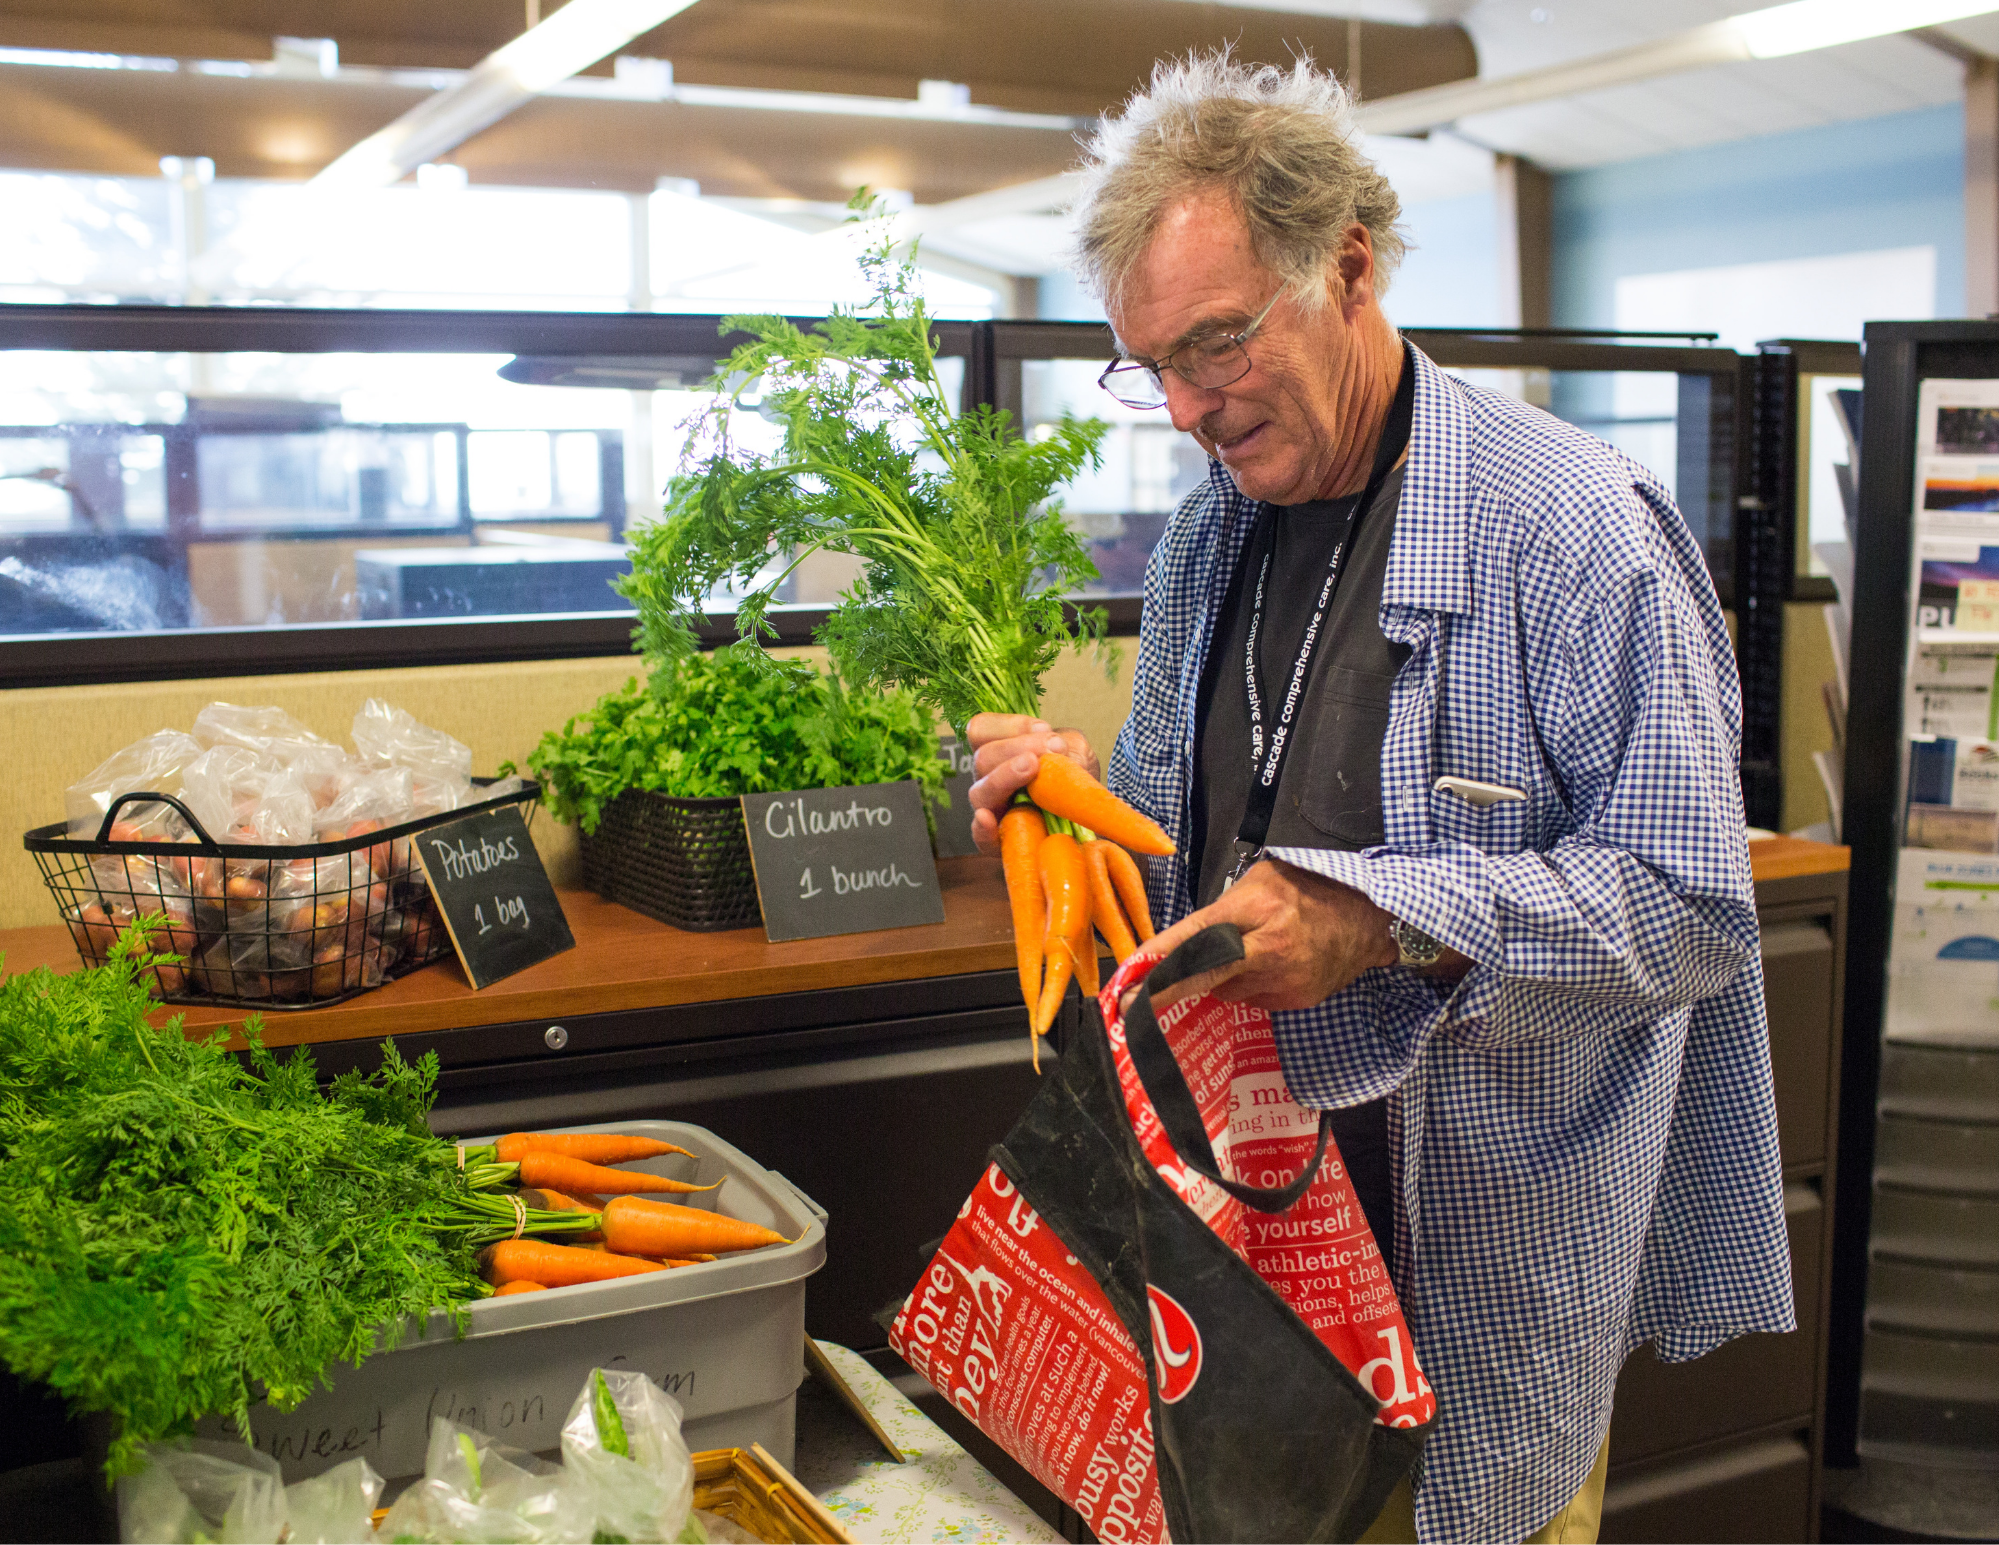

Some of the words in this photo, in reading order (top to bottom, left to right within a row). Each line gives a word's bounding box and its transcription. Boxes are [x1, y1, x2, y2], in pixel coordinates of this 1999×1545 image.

[1255, 554, 1269, 609] cascade
[1246, 613, 1261, 721] comprehensive
[1262, 726, 1288, 786] cascade
[1281, 611, 1322, 723] comprehensive
[1318, 573, 1336, 609] care,
[1329, 542, 1342, 568] inc.
[765, 798, 892, 839] Cilantro
[430, 836, 519, 881] Potatoes
[800, 868, 822, 898] 1
[832, 864, 922, 894] bunch
[474, 907, 492, 934] 1
[498, 895, 530, 929] bag
[1188, 1035, 1214, 1062] worse
[1212, 1021, 1227, 1039] for
[1202, 1052, 1218, 1076] get
[1215, 1040, 1231, 1056] the
[1237, 1058, 1249, 1068] an
[1195, 1080, 1210, 1104] of
[1270, 1111, 1290, 1128] in
[1232, 1149, 1247, 1160] the
[1249, 1145, 1277, 1156] words
[1260, 1167, 1294, 1188] on
[1307, 1190, 1345, 1210] how
[1256, 1206, 1351, 1244] yourself
[972, 1220, 990, 1244] that
[991, 1238, 1014, 1268] flows
[1015, 1266, 1038, 1288] over
[1039, 1285, 1058, 1304] the
[1060, 1300, 1089, 1329] water
[977, 1205, 995, 1230] live
[995, 1226, 1018, 1252] near
[1019, 1249, 1038, 1271] the
[1039, 1268, 1076, 1300] ocean
[1077, 1297, 1100, 1320] and
[1098, 1313, 1135, 1352] inhale
[1299, 1276, 1342, 1297] you
[1348, 1264, 1379, 1285] the
[1348, 1284, 1390, 1306] helps
[942, 1296, 972, 1356] than
[1005, 1321, 1020, 1351] health
[1017, 1295, 1031, 1324] goals
[1024, 1330, 1032, 1339] a
[1027, 1305, 1043, 1332] year.
[1313, 1312, 1346, 1329] and
[1012, 1338, 1028, 1369] times
[1024, 1314, 1055, 1372] computer.
[1005, 1367, 1016, 1390] four
[1025, 1402, 1045, 1452] moves
[1041, 1383, 1054, 1403] at
[1049, 1343, 1073, 1384] such
[1067, 1330, 1078, 1344] a
[1054, 1342, 1088, 1407] implement
[999, 1389, 1010, 1409] this
[1050, 1442, 1062, 1464] you
[1056, 1422, 1071, 1443] two
[1068, 1392, 1083, 1422] steps
[1077, 1353, 1099, 1394] behind.
[1050, 1406, 1061, 1420] to
[1056, 1462, 1070, 1476] it
[1064, 1432, 1085, 1465] now,
[1077, 1411, 1091, 1431] do
[1084, 1397, 1096, 1412] it
[1092, 1360, 1111, 1400] now!
[1104, 1385, 1139, 1446] works
